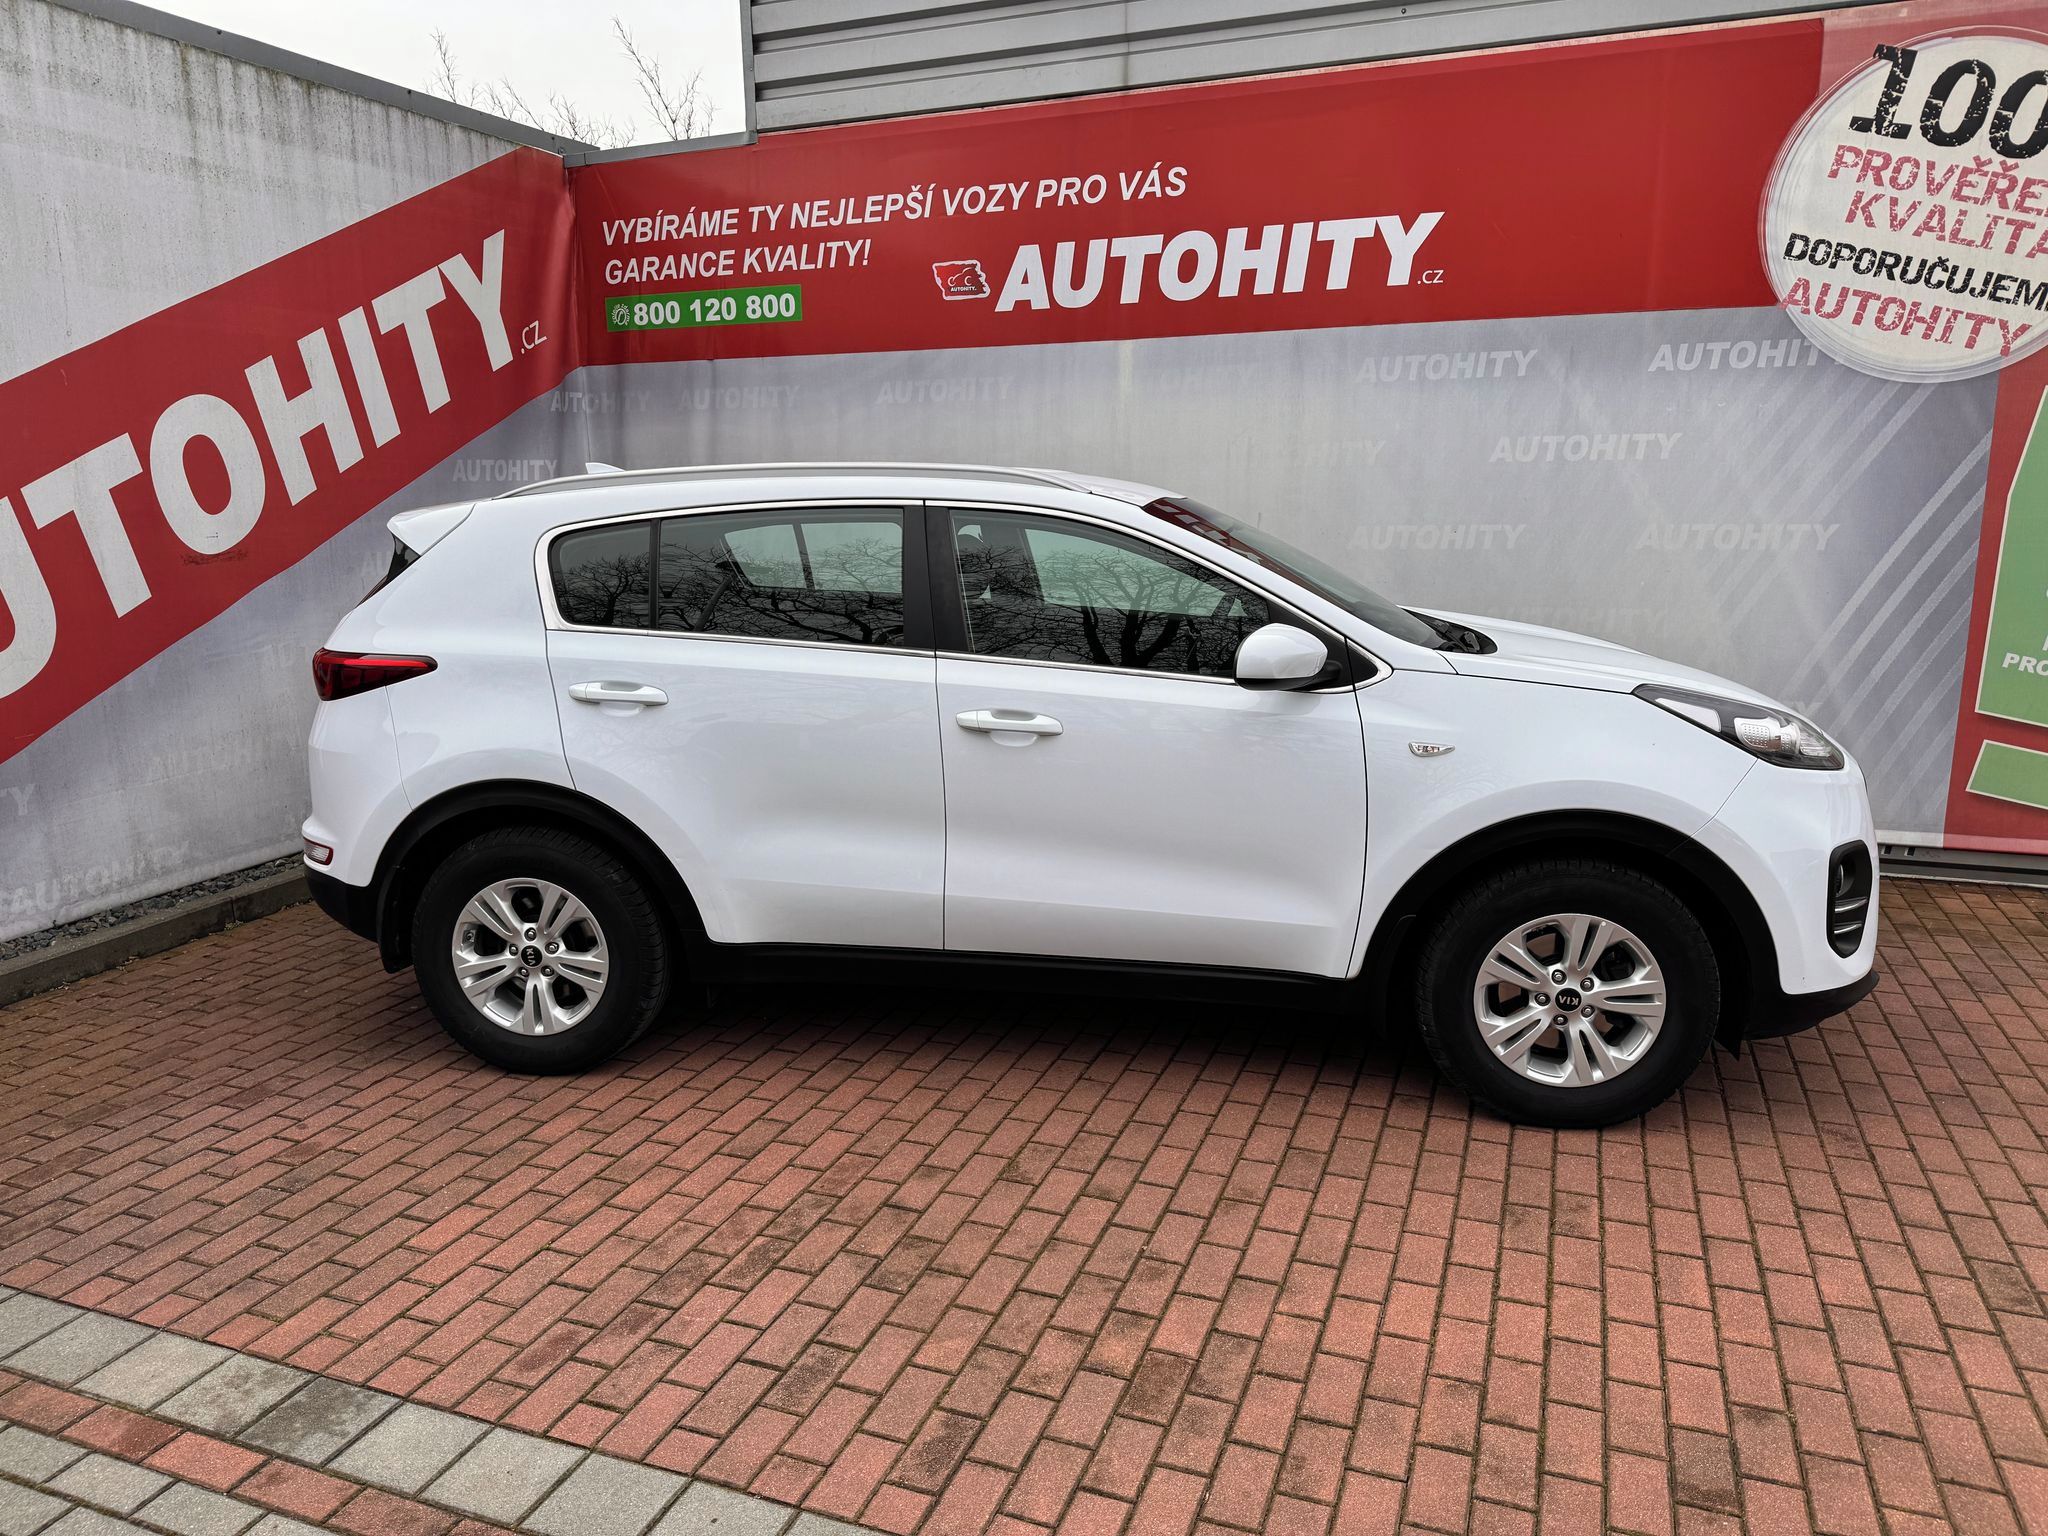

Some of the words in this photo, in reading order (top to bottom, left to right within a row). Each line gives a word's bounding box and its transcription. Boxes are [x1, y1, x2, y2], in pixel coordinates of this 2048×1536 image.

[1828, 145, 2048, 217] PROVĚŘE
[602, 206, 740, 247] VYBÍRÁME
[748, 203, 785, 233] TY
[790, 184, 936, 230] NEJLEPŠÍ
[942, 181, 1030, 216] VOZY
[1035, 174, 1107, 208] PRO
[1118, 161, 1188, 201] VÁS
[605, 249, 736, 285] GARANCE
[742, 239, 872, 274] KVALITY!
[1783, 232, 2048, 312] DOPORUČUJEM
[633, 300, 681, 326] 800
[689, 296, 737, 322] 120
[745, 293, 796, 320] 800
[1779, 277, 2032, 358] AUTOHITY
[1355, 349, 1538, 384] AUTOHITY
[1648, 338, 1834, 374] AUTOHIT
[1489, 432, 1682, 464] AUTOHITY
[1346, 524, 1529, 552] AUTOHITY
[1635, 522, 1841, 552] AUTOHITY
[1558, 994, 1580, 1006] KIA
